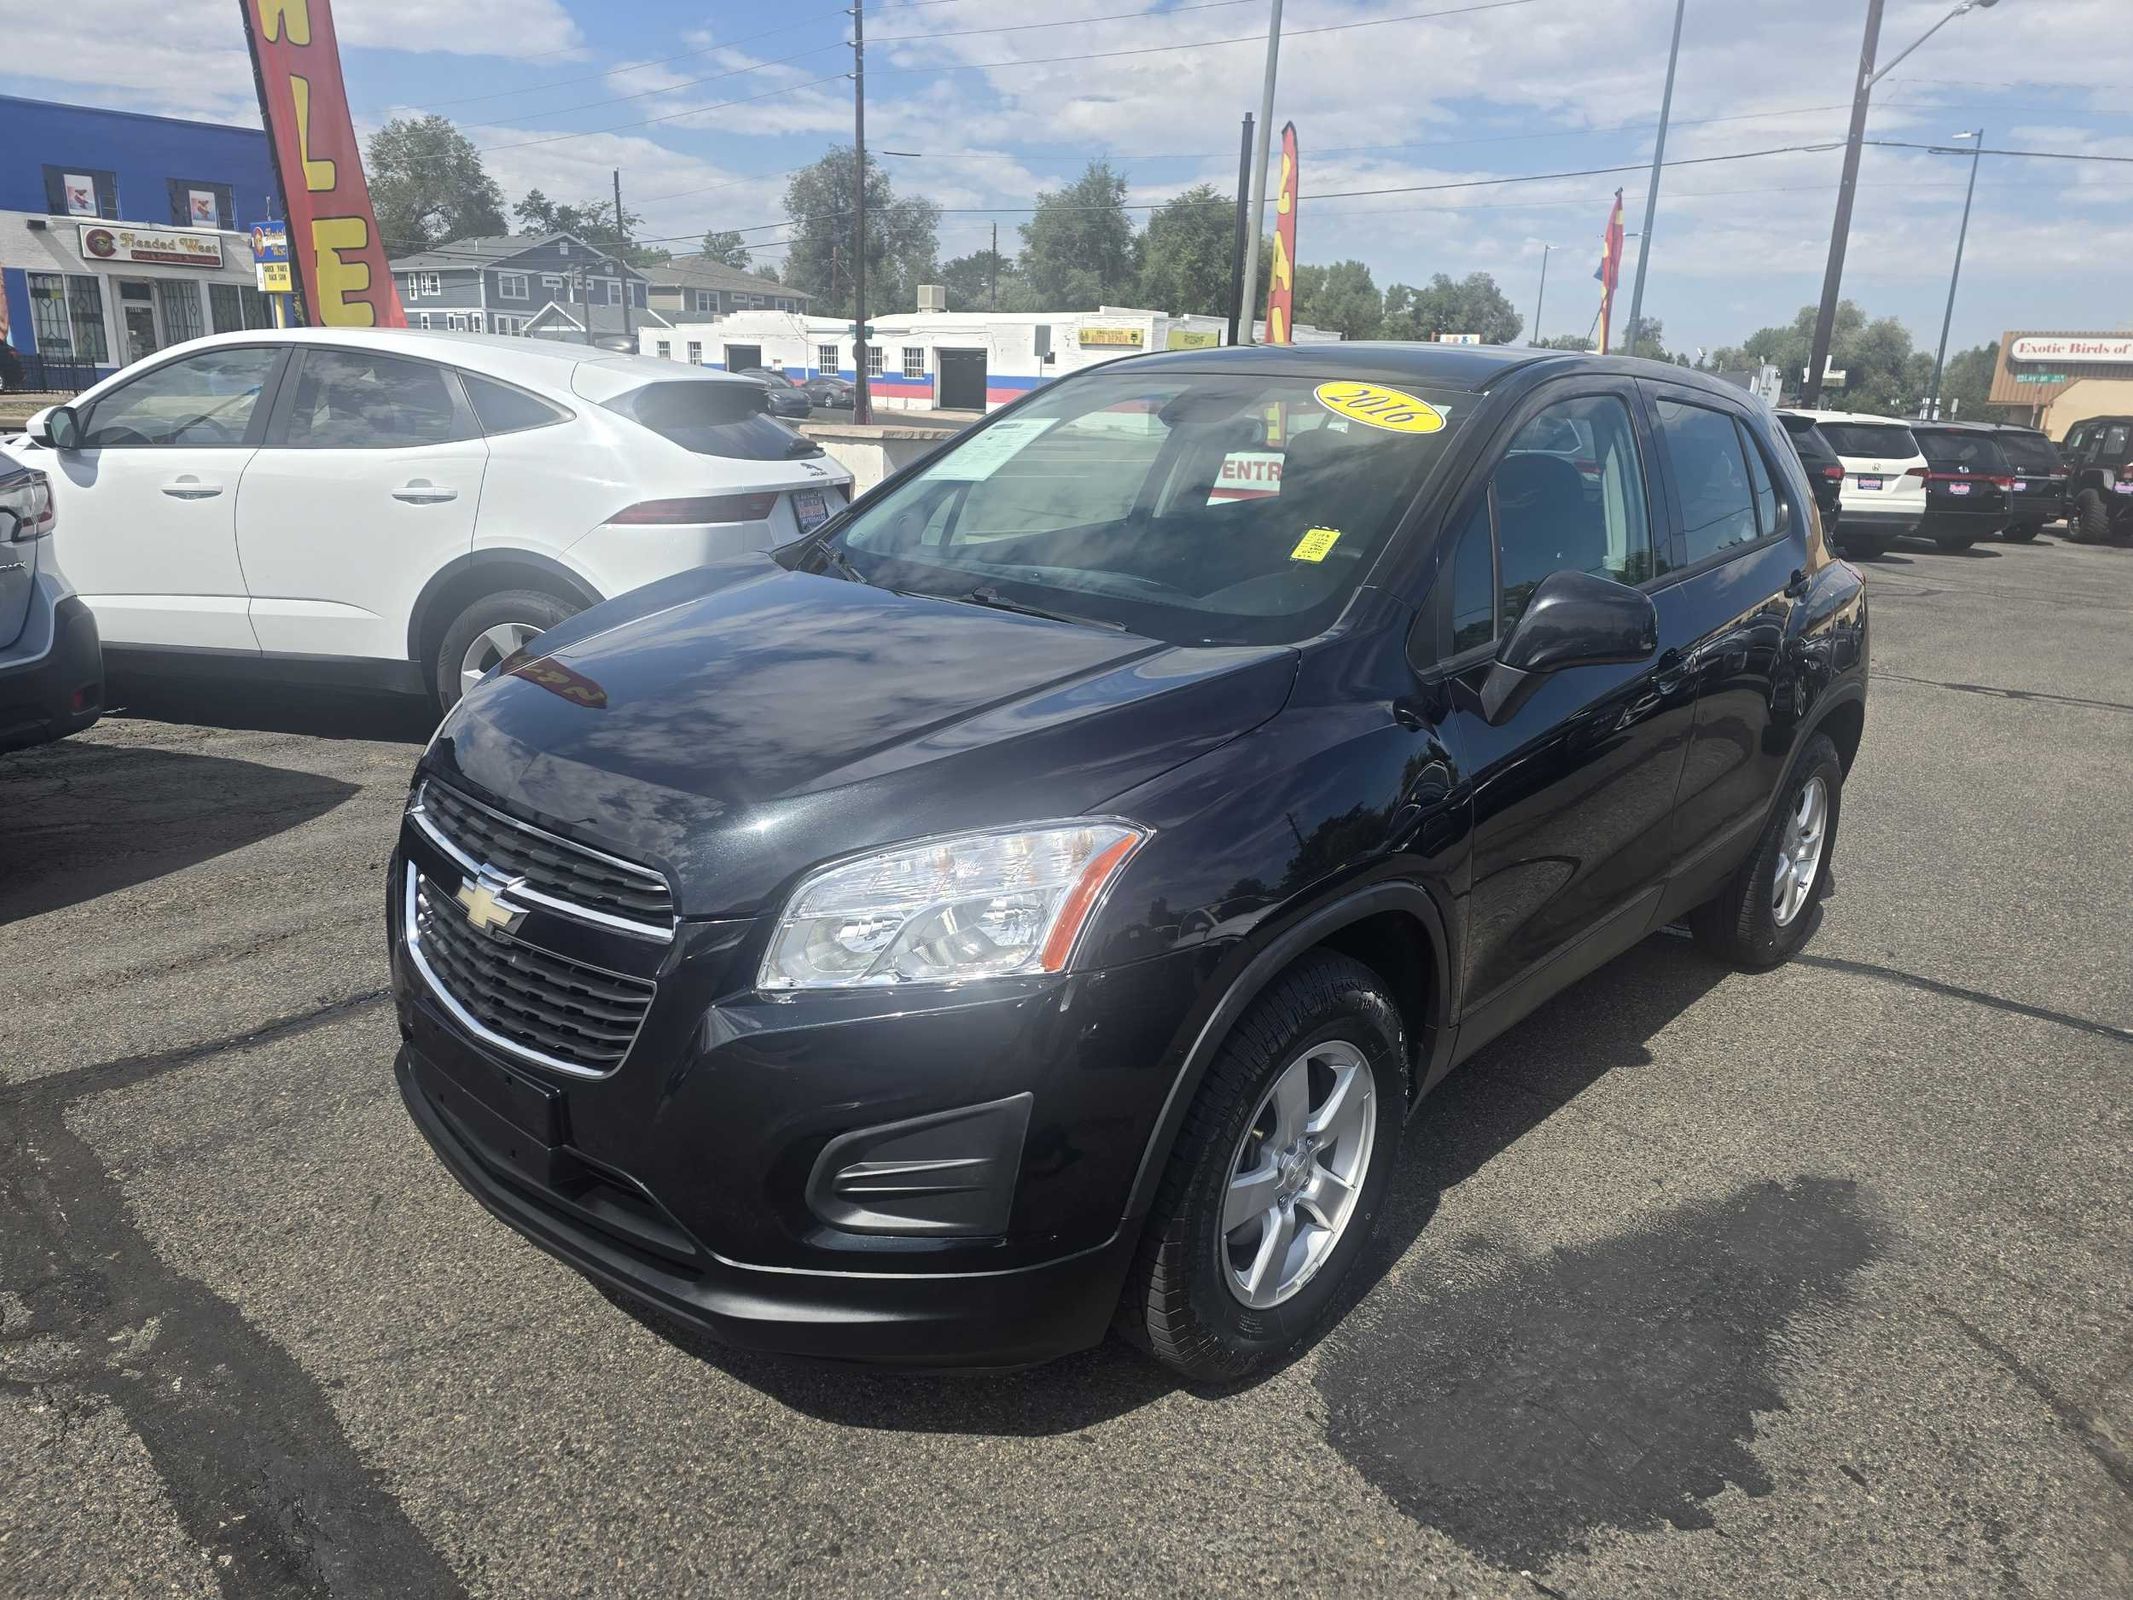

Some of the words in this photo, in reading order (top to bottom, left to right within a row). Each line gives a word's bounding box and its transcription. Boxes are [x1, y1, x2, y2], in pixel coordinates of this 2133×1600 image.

[119, 232, 177, 251] Headed
[178, 237, 219, 254] West
[2019, 342, 2065, 354] Exotic
[2069, 343, 2110, 354] Birds
[2113, 343, 2132, 354] of
[1325, 389, 1433, 423] 2016
